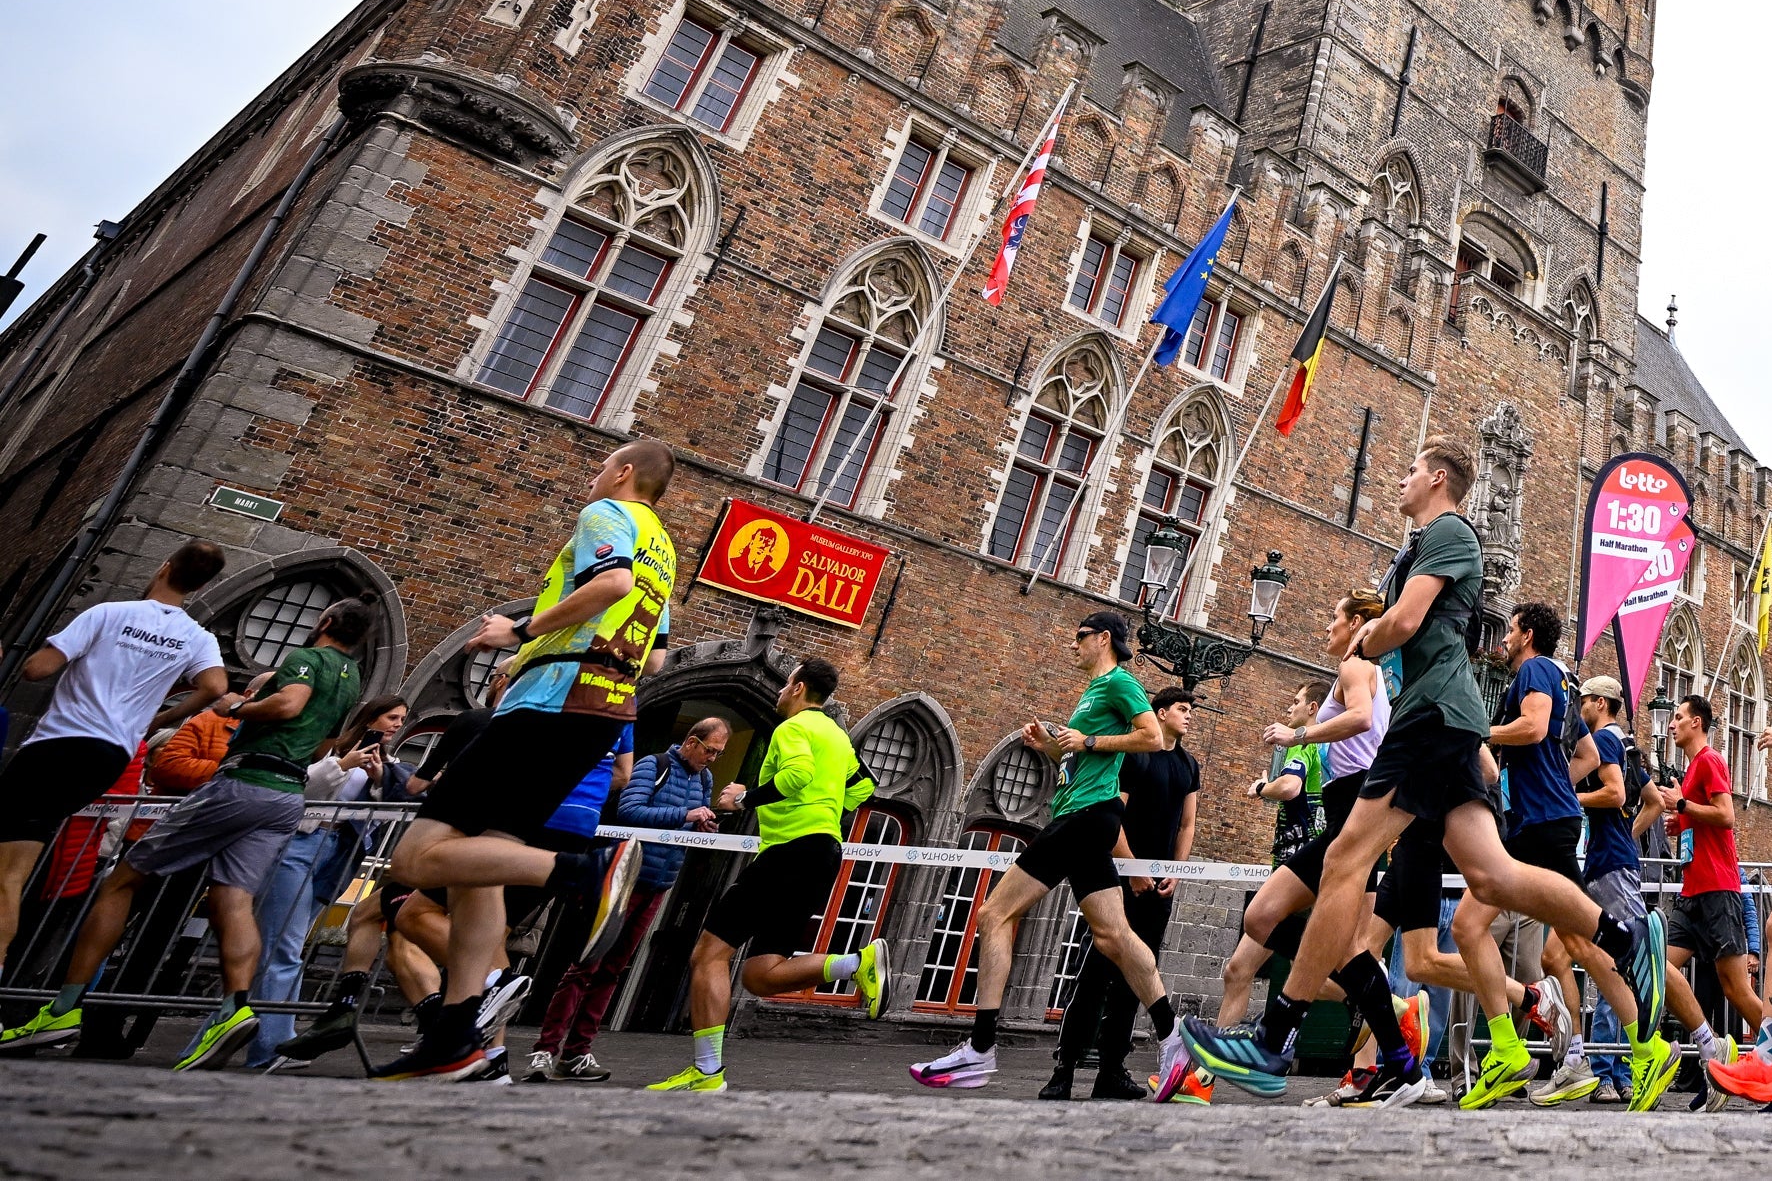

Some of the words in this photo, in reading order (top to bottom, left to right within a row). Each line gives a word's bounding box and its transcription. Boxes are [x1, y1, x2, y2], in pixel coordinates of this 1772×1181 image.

[234, 498, 259, 510] MARKT
[1607, 499, 1662, 535] 1:30
[810, 533, 835, 549] MUSEUM
[834, 543, 861, 557] GALLERY
[860, 550, 874, 561] XPO
[1599, 538, 1614, 548] Half
[1614, 540, 1648, 553] Marathon
[800, 550, 867, 584] SALVADOR
[786, 566, 862, 615] DALI
[1624, 597, 1637, 607] Half
[1637, 589, 1669, 601] Marathon
[478, 986, 501, 1014] HOKA
